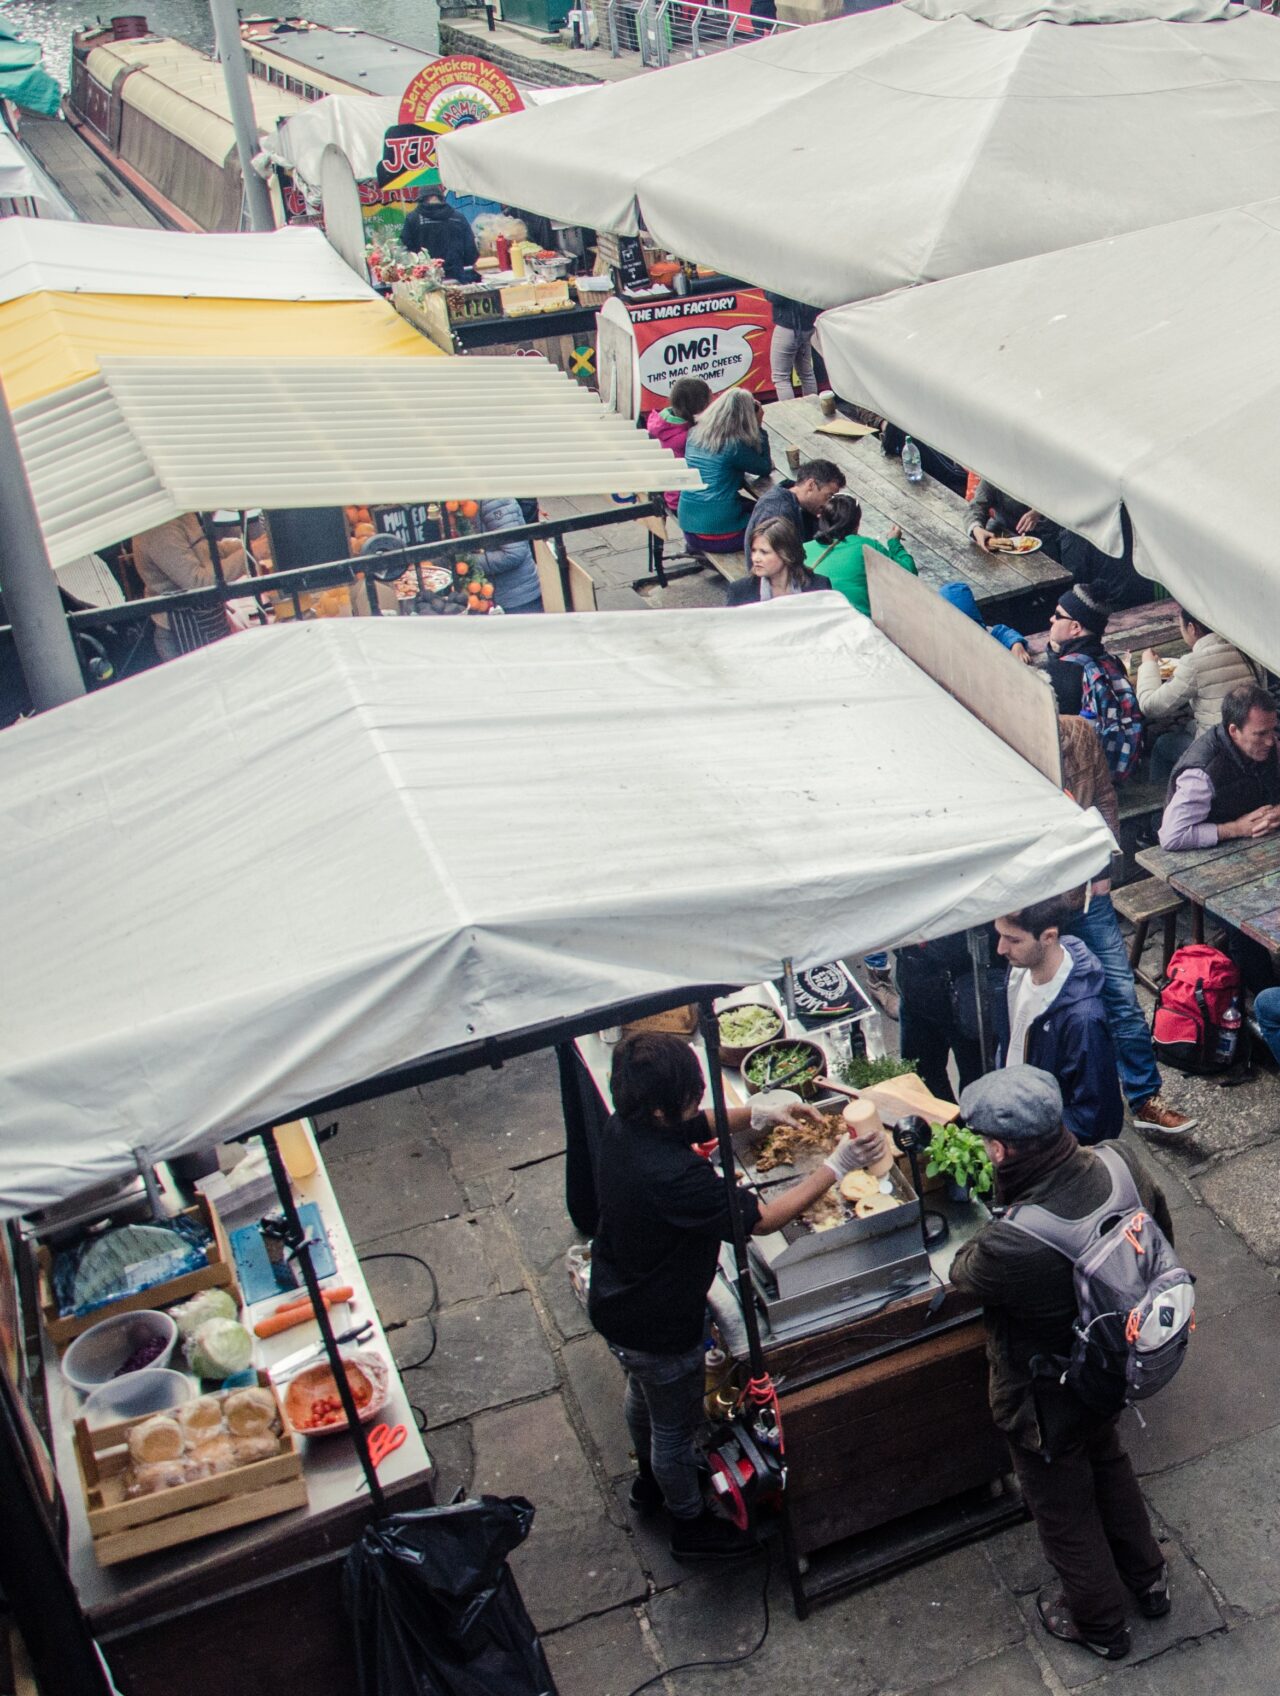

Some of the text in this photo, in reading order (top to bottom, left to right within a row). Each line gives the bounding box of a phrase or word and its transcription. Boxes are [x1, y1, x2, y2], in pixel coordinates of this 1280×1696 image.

[402, 79, 426, 113] Jerk
[421, 59, 477, 82] Chicken
[480, 61, 516, 102] Wraps
[382, 135, 440, 173] JER
[630, 296, 735, 323] THE MAC FACTORY
[663, 334, 719, 366] OMG!
[647, 354, 743, 384] THIS MAC AND CHEESE
